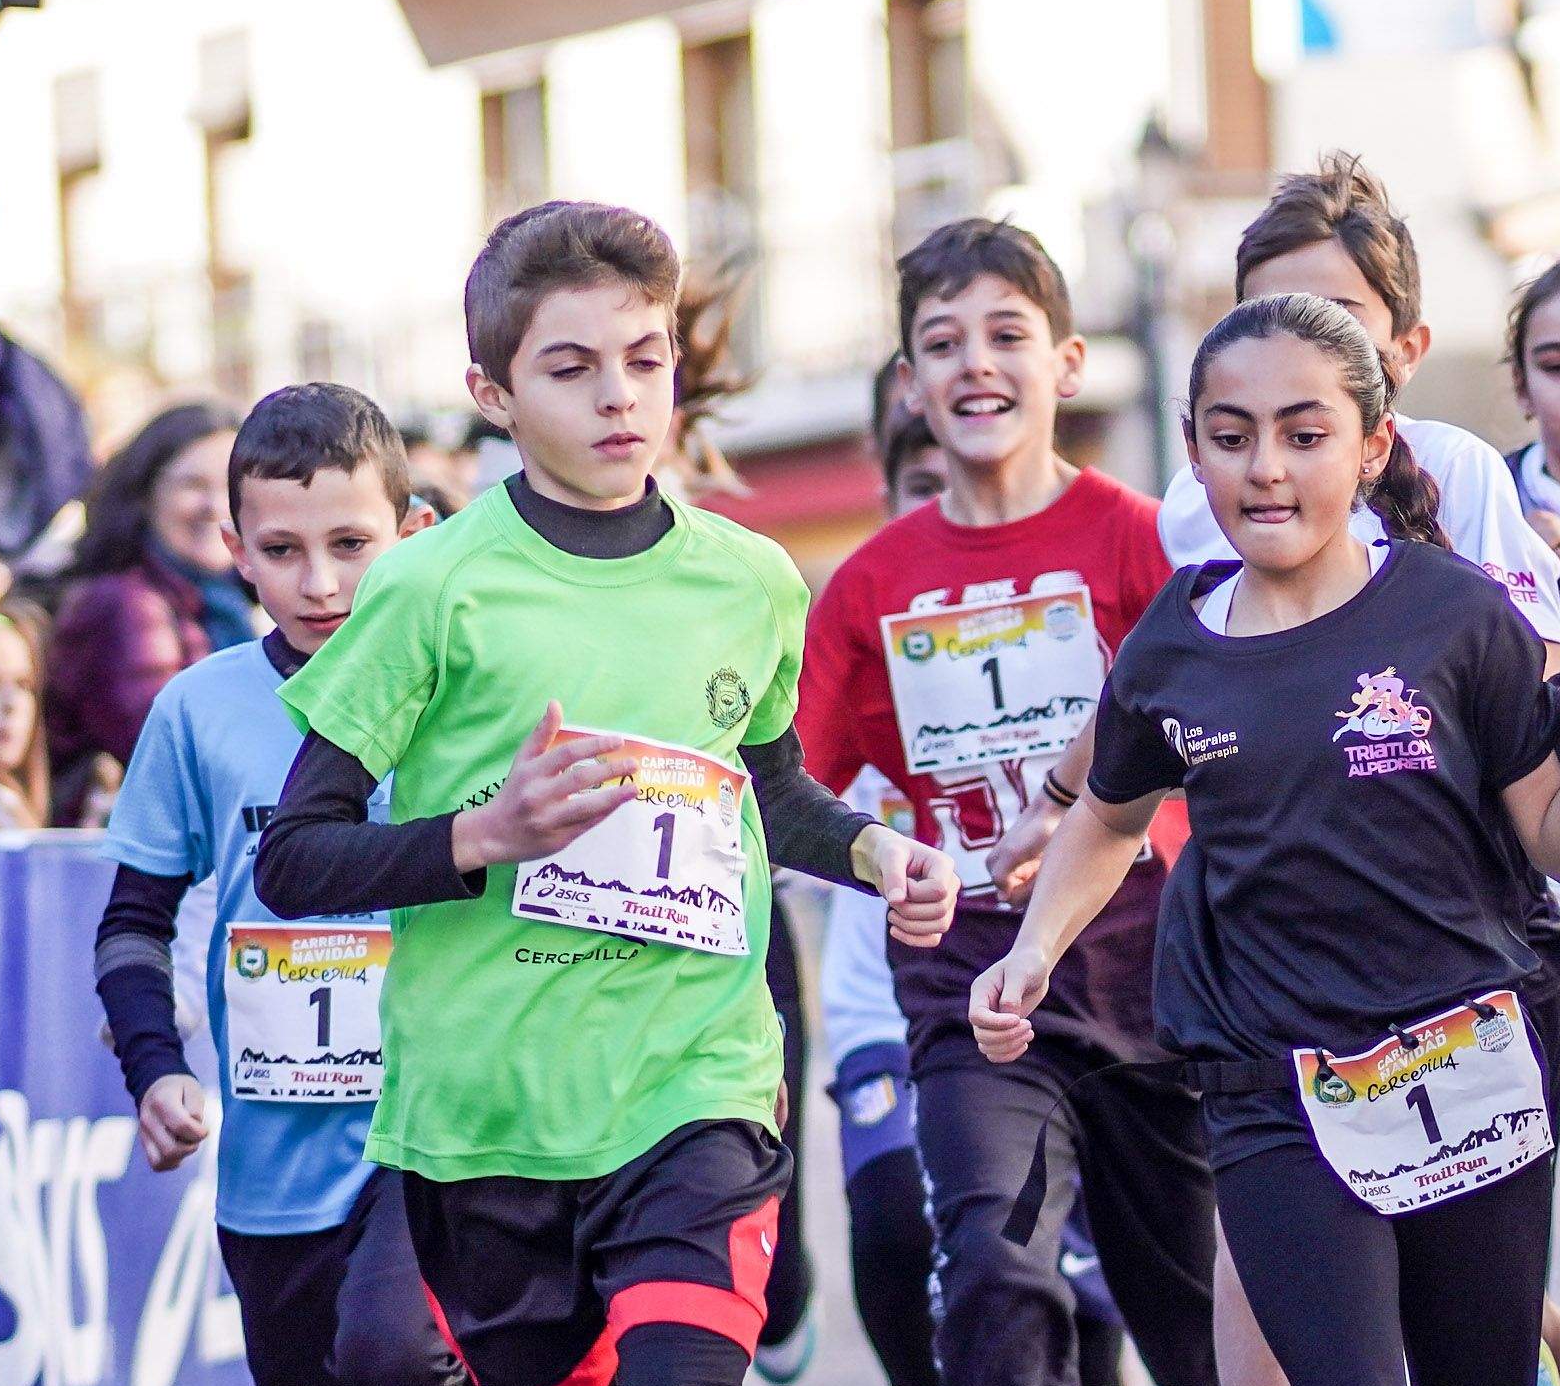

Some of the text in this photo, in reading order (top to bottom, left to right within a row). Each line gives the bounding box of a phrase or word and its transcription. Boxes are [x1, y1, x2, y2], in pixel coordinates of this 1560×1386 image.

[981, 657, 1005, 710] 1
[1184, 725, 1203, 740] Los
[1187, 730, 1238, 754] Negrales
[641, 756, 698, 771] CARRERA
[1347, 755, 1438, 778] ALPEDRETE
[640, 769, 705, 787] NAVIDAD
[653, 812, 676, 880] 1
[555, 888, 592, 903] asics
[622, 899, 690, 925] Trail Run
[292, 933, 355, 951] CARRERA
[291, 945, 368, 965] NAVIDAD
[309, 987, 332, 1047] 1
[1377, 1028, 1434, 1071] CARRA
[1379, 1033, 1448, 1082] NAVIDAD
[291, 1071, 363, 1085] Trail Run
[1405, 1083, 1443, 1145] 1
[1414, 1155, 1488, 1188] Trail Run
[1367, 1184, 1391, 1196] asics
